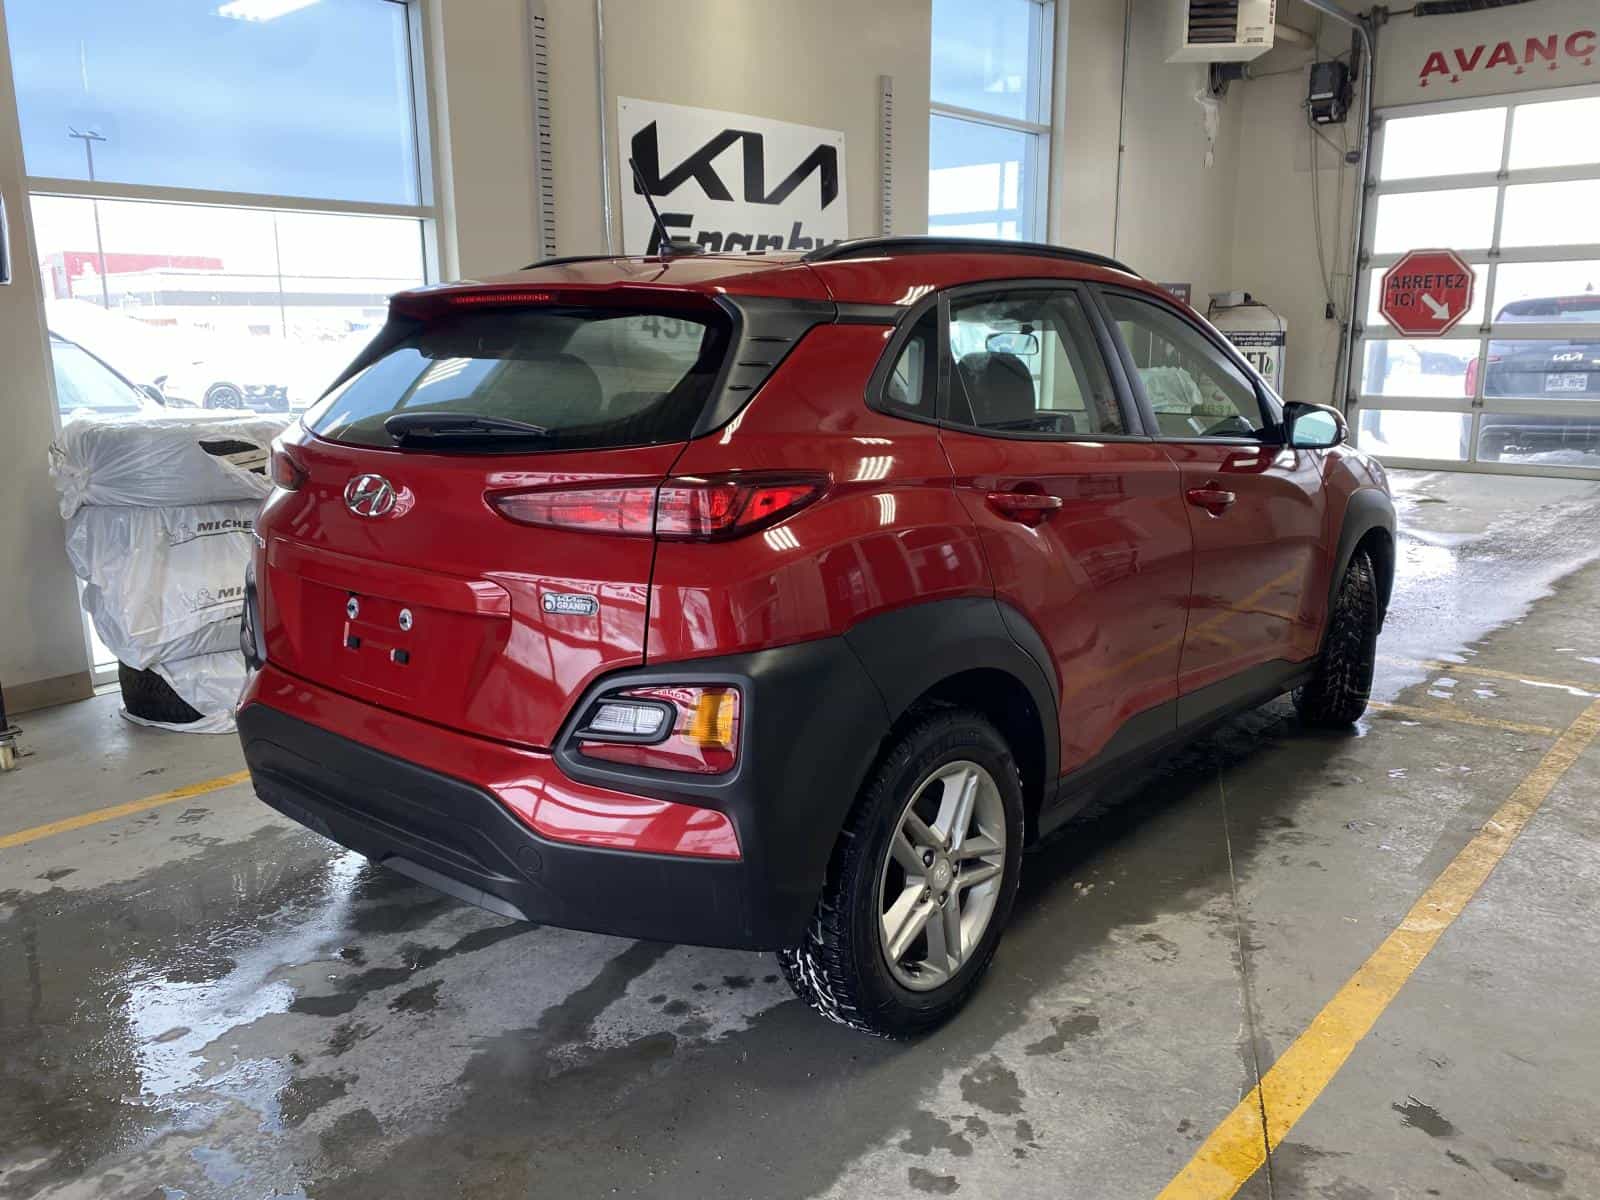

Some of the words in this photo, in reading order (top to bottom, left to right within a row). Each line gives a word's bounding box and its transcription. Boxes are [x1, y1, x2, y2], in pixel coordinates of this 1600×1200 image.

[1419, 29, 1596, 78] AVANC
[631, 120, 839, 211] KIA
[1395, 292, 1415, 307] ICI
